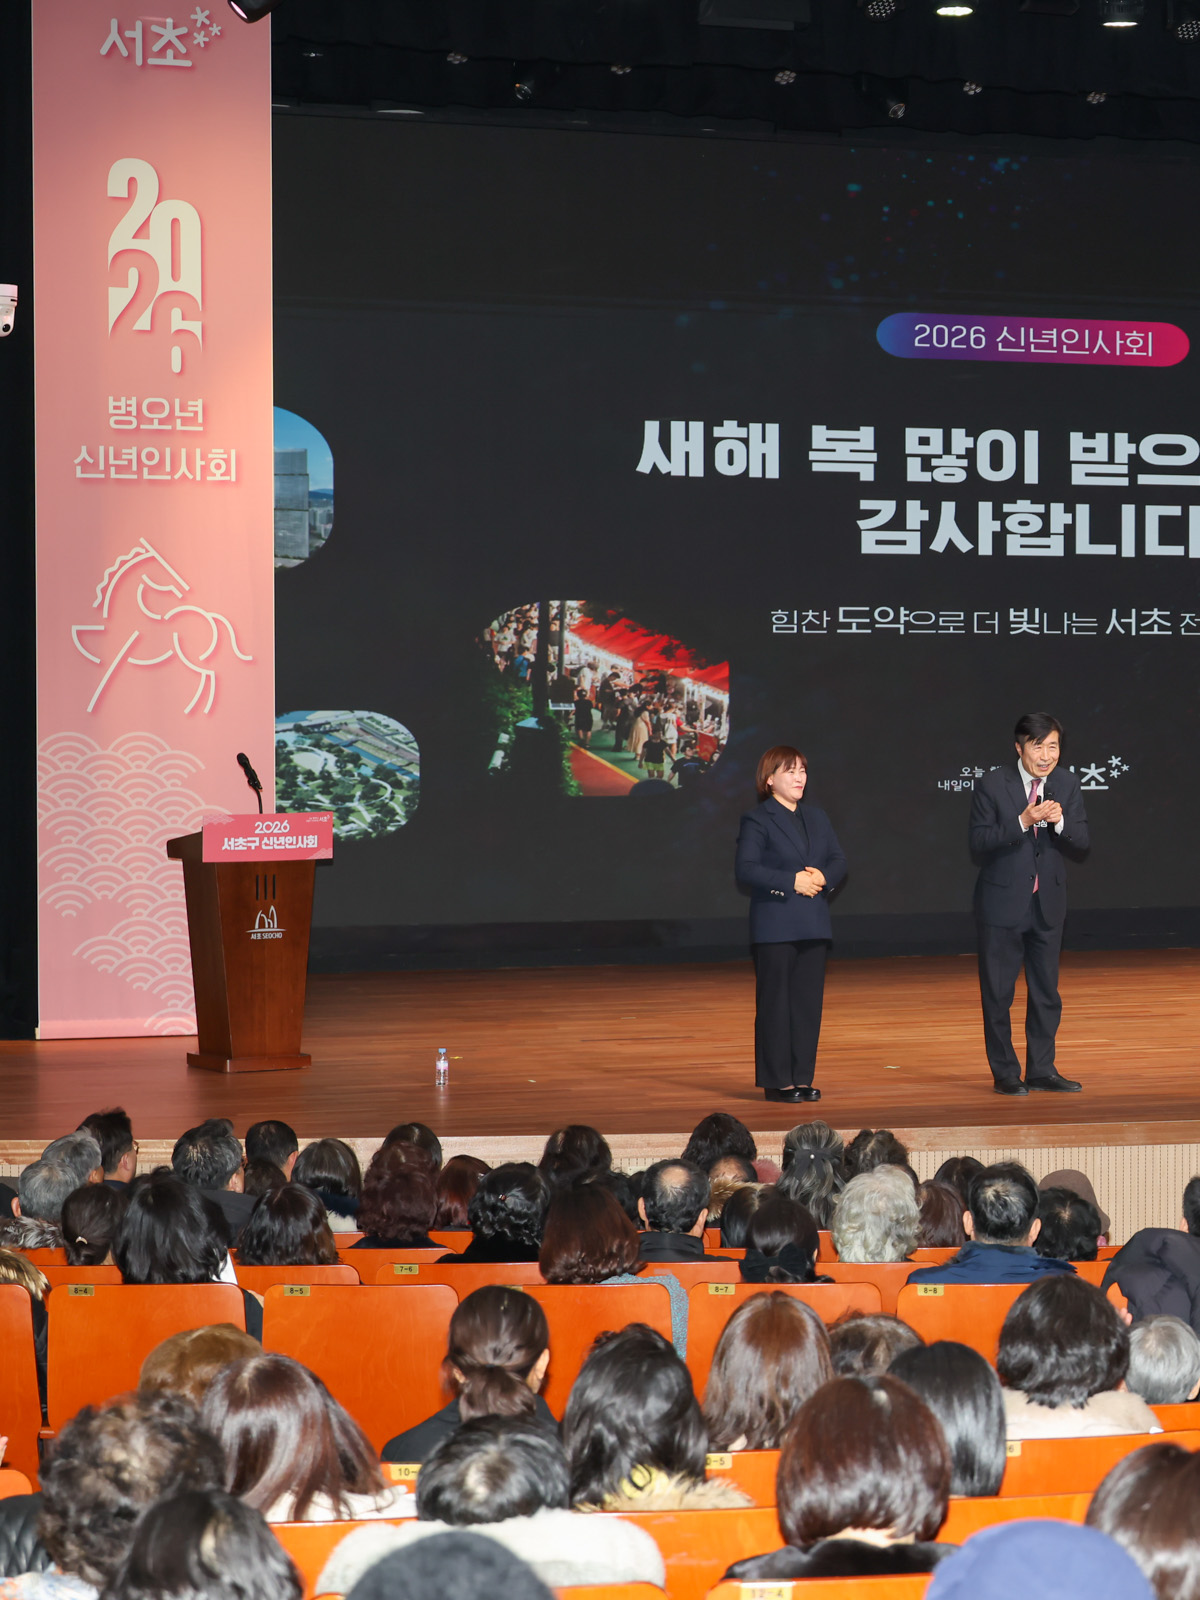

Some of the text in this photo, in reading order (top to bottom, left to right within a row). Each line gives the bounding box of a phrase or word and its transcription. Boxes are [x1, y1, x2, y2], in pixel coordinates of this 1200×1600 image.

[99, 17, 193, 67] 서초
[913, 323, 1153, 357] 2026 신년인사회
[107, 395, 204, 433] 병오년
[73, 445, 237, 483] 신년인사회
[635, 419, 780, 479] 새해
[808, 424, 878, 482] 복
[904, 427, 1039, 484] 많이
[770, 609, 831, 634] 힘찬
[836, 606, 966, 635] 도약으로
[973, 611, 999, 635] 더
[1009, 607, 1099, 635] 빛나는
[1105, 607, 1173, 636] 서초
[937, 779, 975, 791] 내일이
[959, 766, 985, 777] 오늘
[254, 820, 290, 834] 2026
[221, 835, 318, 850] 서초구 신년인사회
[262, 931, 283, 940] SEOCHO
